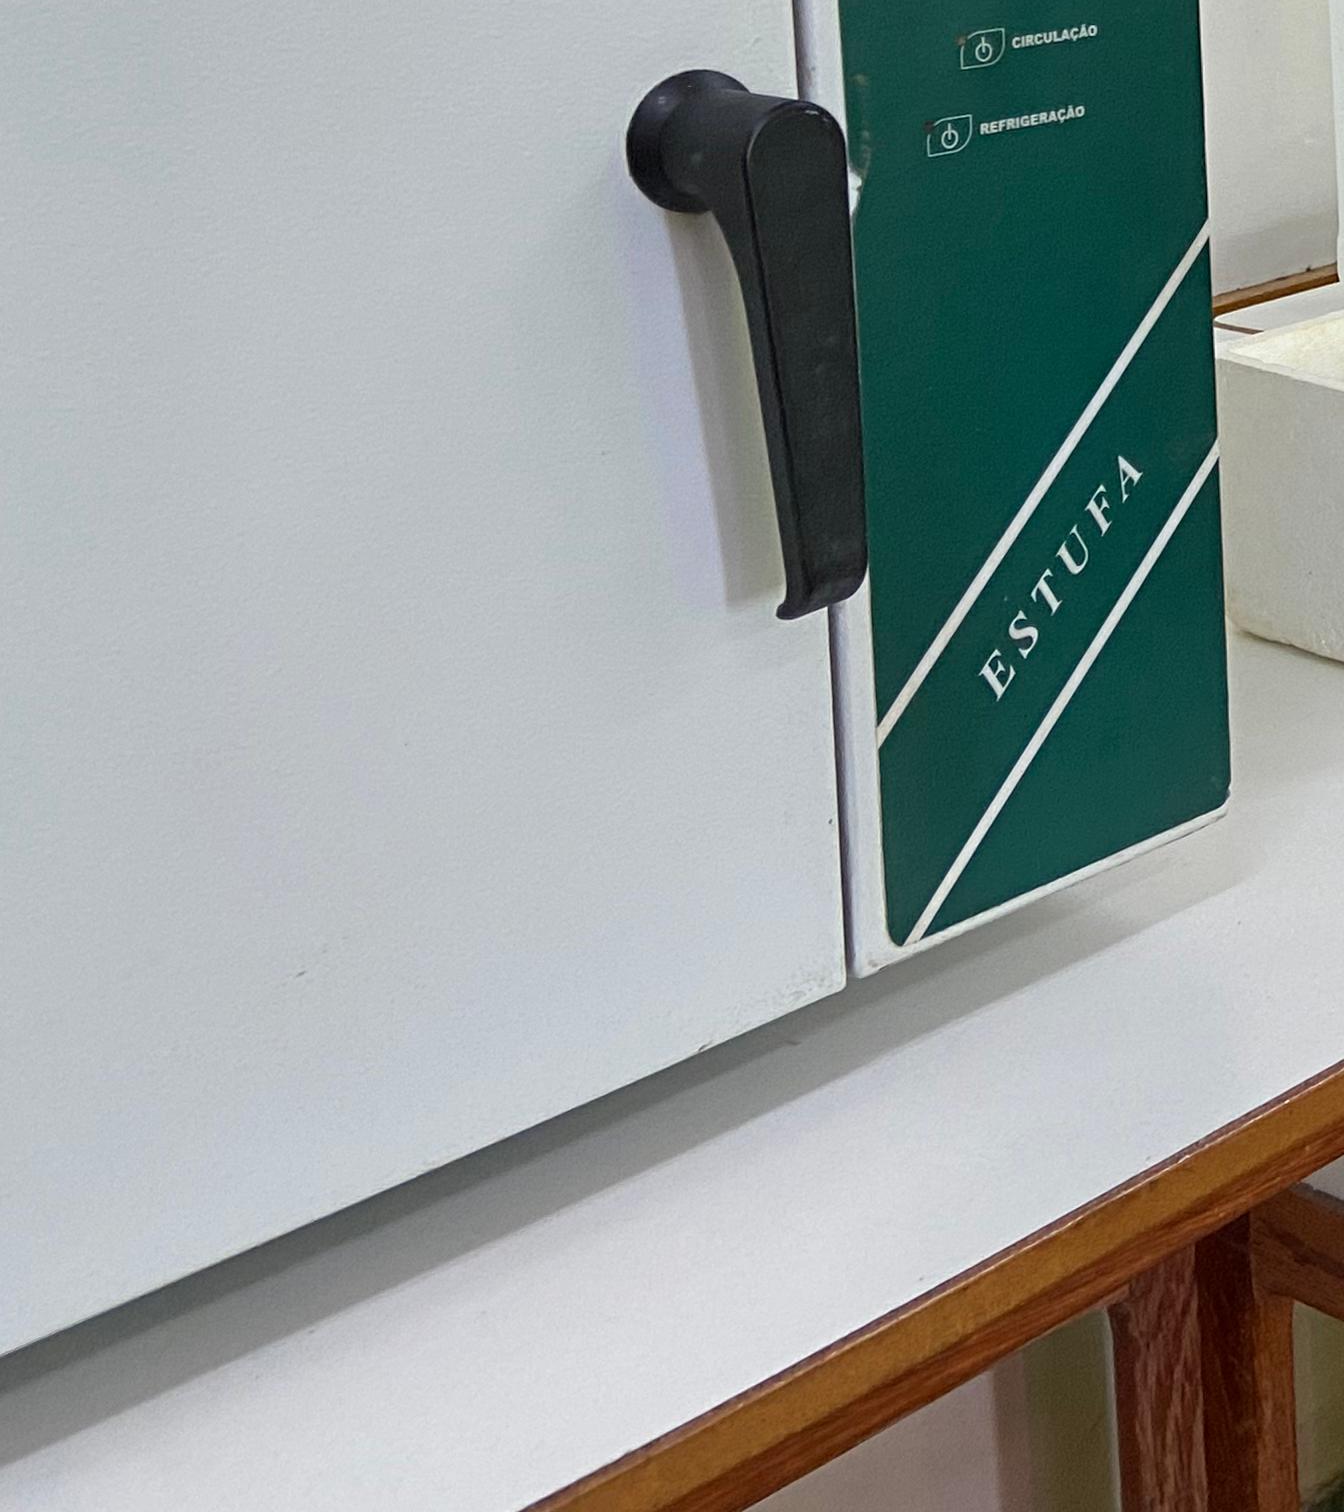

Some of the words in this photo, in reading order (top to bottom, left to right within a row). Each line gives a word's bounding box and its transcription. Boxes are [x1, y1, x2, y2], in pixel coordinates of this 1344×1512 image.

[1011, 24, 1098, 48] CIRCULAÇÃO
[979, 105, 1085, 135] REFRIGERAÇÃO
[977, 454, 1144, 702] ESTUFA
